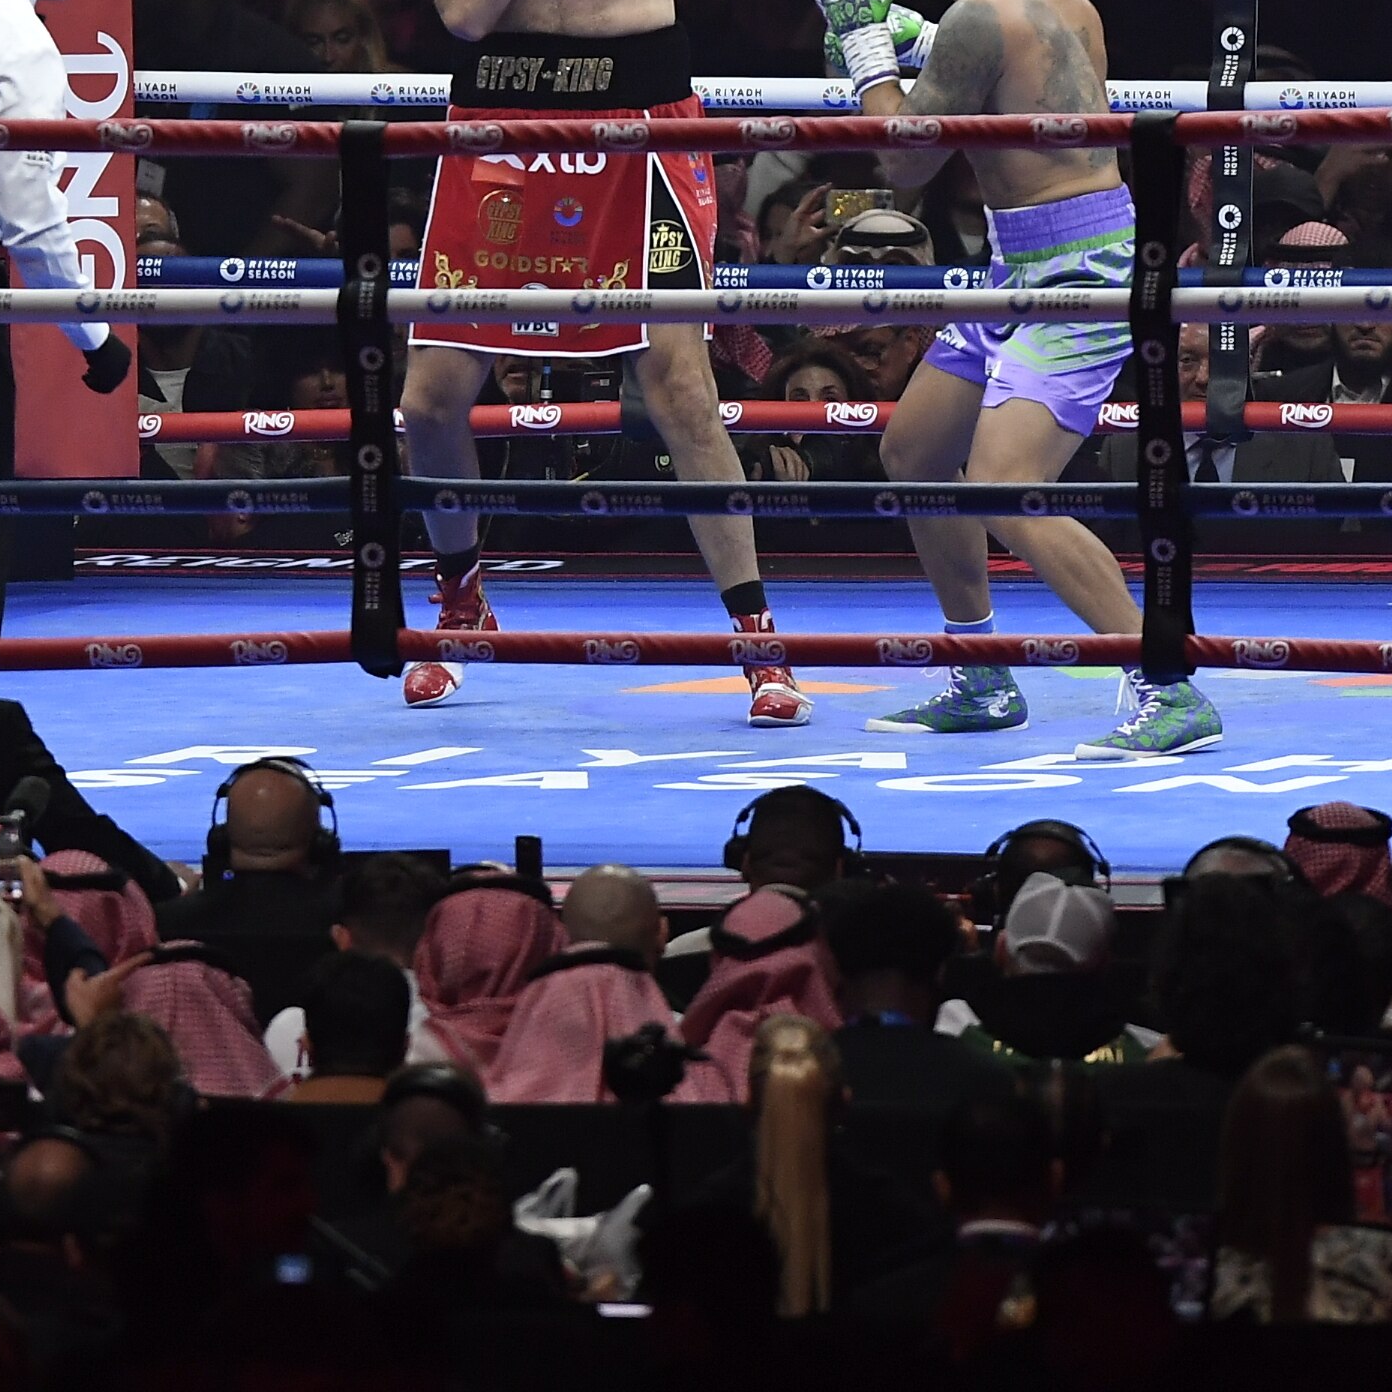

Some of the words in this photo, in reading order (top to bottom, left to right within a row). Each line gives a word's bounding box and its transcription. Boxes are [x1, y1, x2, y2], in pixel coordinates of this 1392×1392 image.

[476, 55, 544, 91] GYPSY
[553, 57, 614, 92] KING
[265, 86, 311, 94] RIYADH
[399, 86, 445, 95] RIYADH
[715, 88, 762, 97] RIYADH
[1123, 91, 1172, 100] RIYADH
[1308, 91, 1355, 100] RIYADH
[57, 31, 130, 289] RNG
[652, 231, 684, 248] YPSY
[249, 260, 297, 269] RIYADH
[248, 271, 296, 280] SEASON
[715, 268, 748, 276] YADH
[836, 269, 884, 277] RIYADH
[1294, 270, 1343, 278] RIYADH
[715, 279, 748, 287] ASON
[835, 279, 883, 287] SEASON
[1294, 280, 1341, 288] SEASON
[508, 405, 562, 429] RING
[826, 403, 878, 426] RING
[1279, 404, 1332, 428] RING
[243, 412, 294, 435] RING
